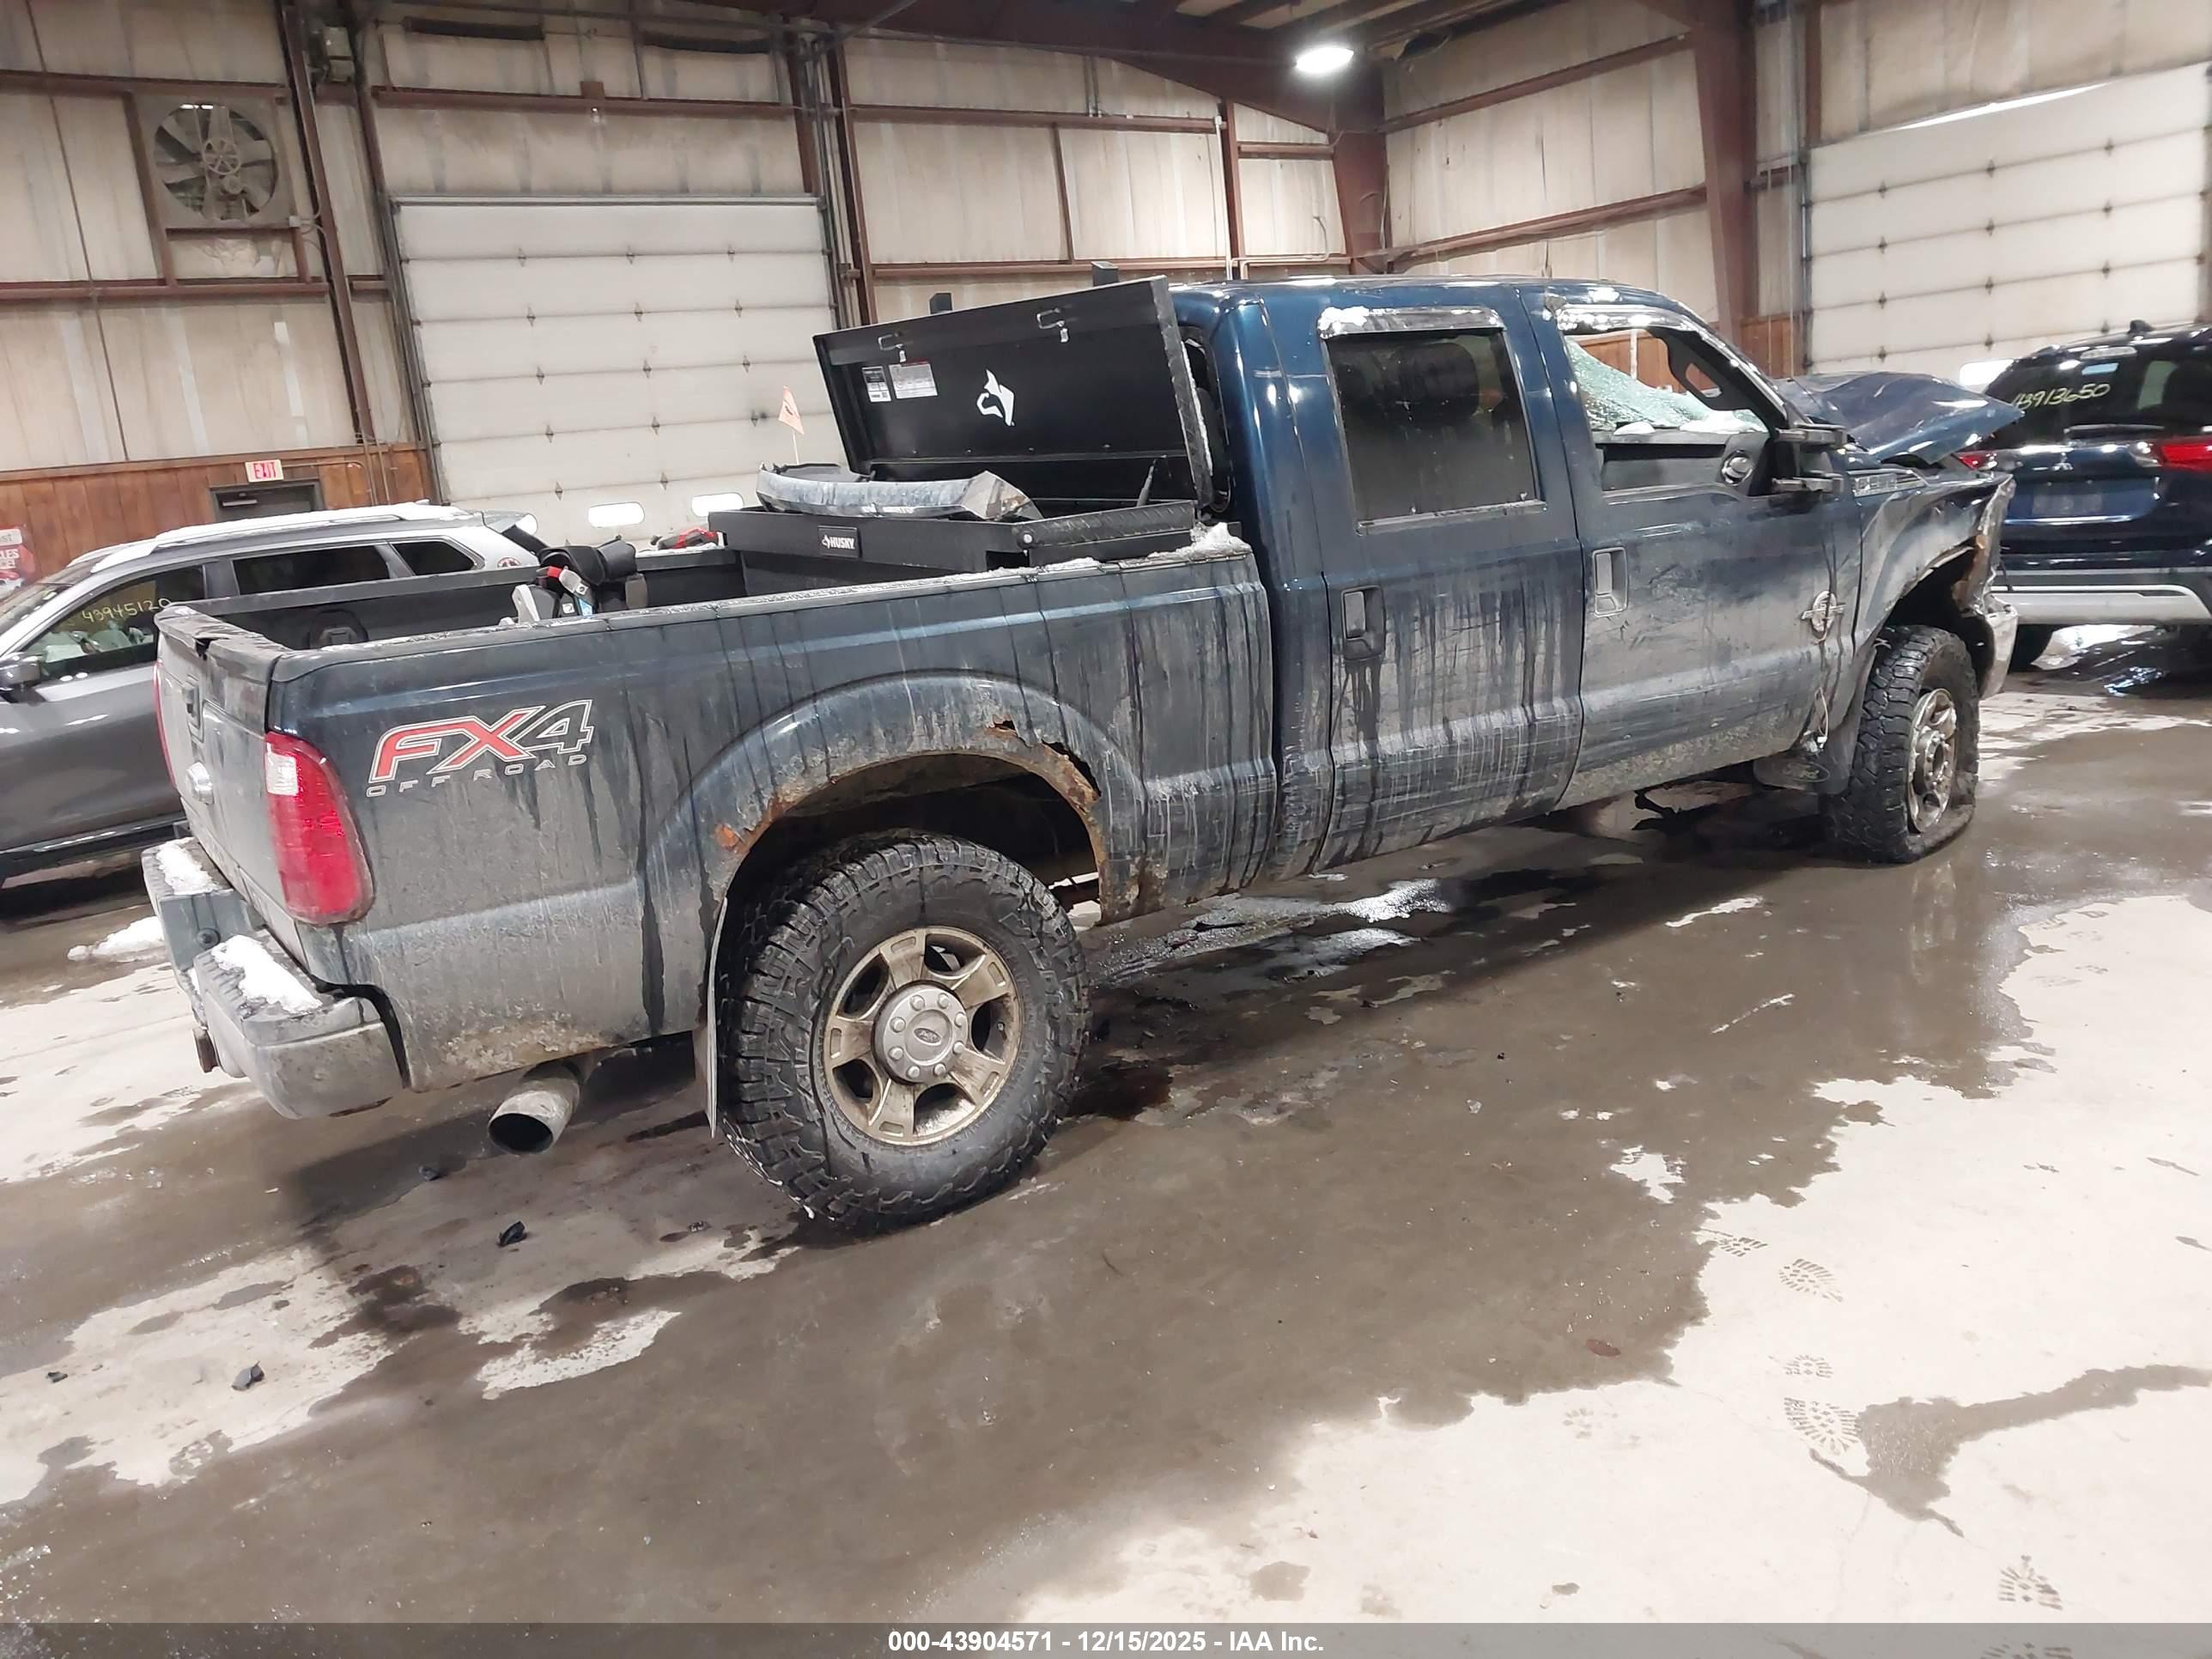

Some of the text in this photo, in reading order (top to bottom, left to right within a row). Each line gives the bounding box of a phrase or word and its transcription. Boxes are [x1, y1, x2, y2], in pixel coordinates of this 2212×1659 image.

[252, 462, 276, 479] EXIT
[830, 536, 855, 550] HUSKY
[82, 598, 172, 623] 43945120
[368, 699, 594, 783] FX4
[366, 754, 587, 798] OFF ROAD
